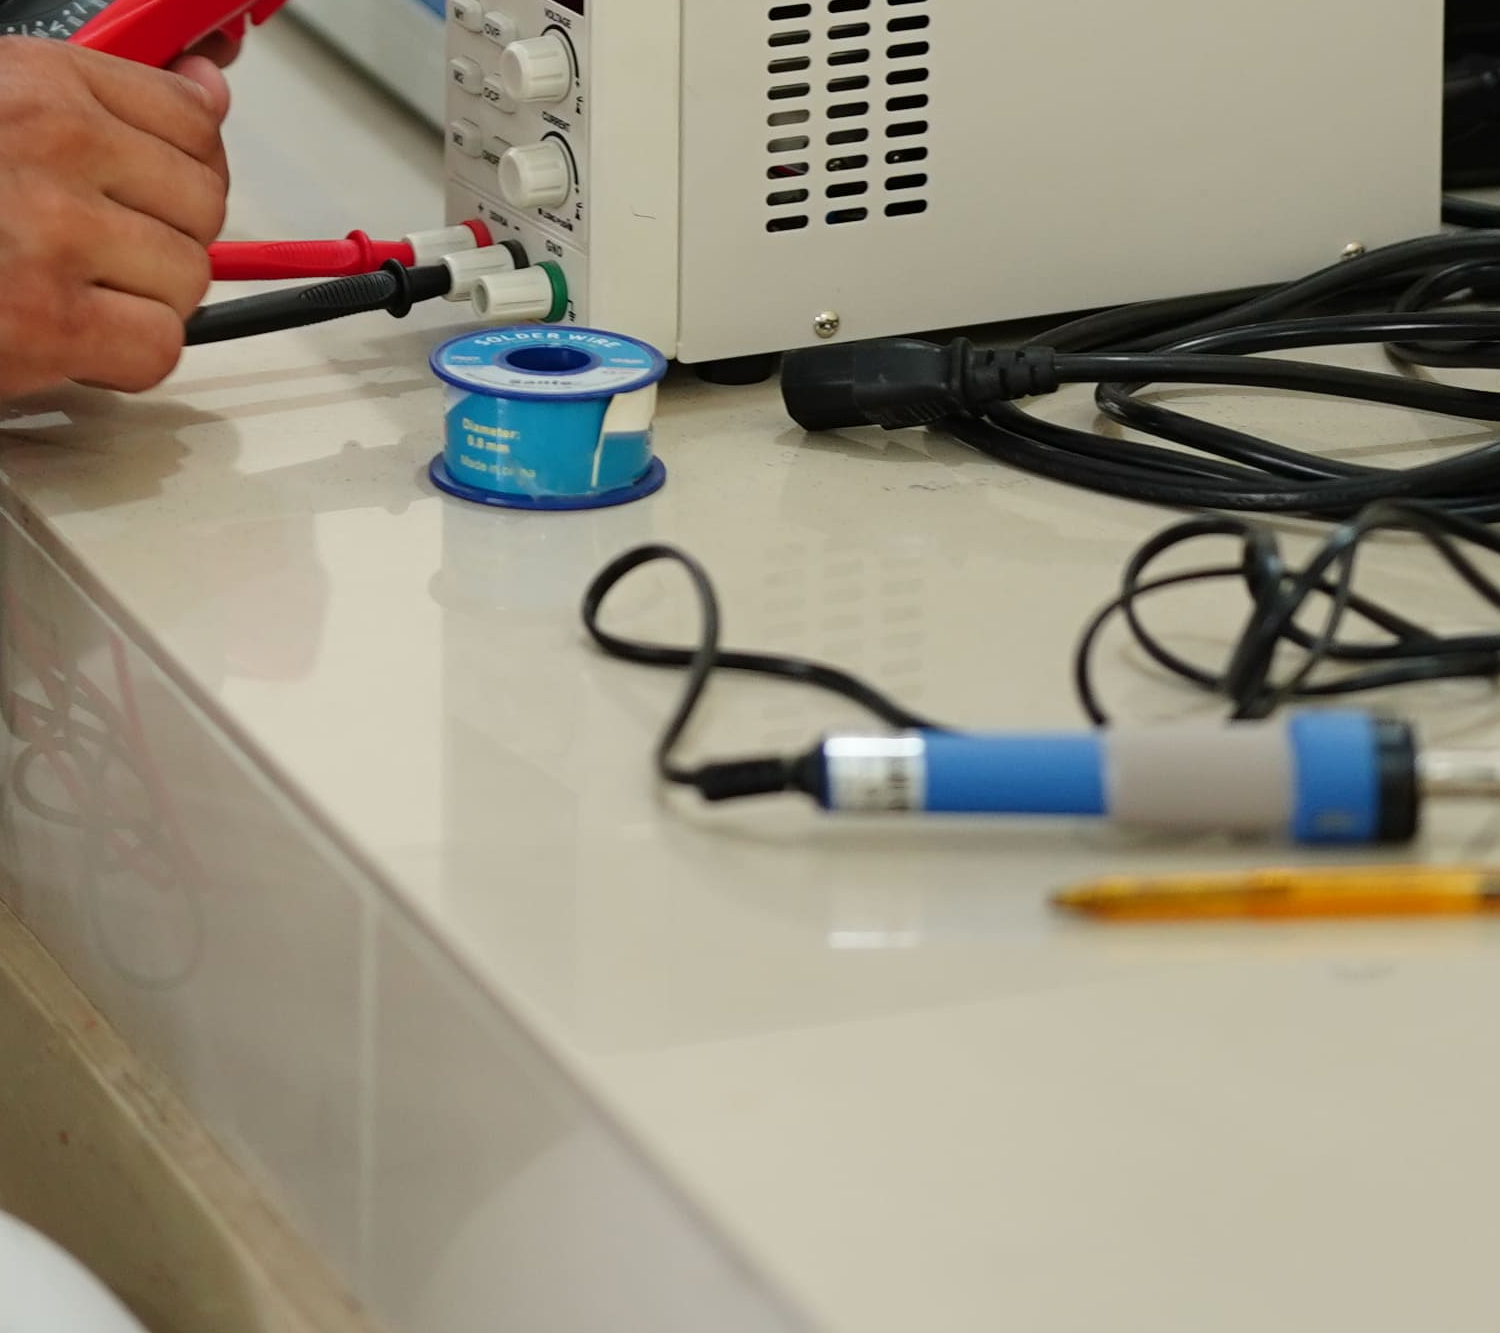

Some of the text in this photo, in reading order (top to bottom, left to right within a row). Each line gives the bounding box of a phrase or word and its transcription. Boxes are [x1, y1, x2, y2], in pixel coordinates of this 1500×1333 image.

[544, 7, 572, 29] VOLTAGE
[483, 23, 501, 38] OVP
[545, 239, 563, 258] GND
[474, 332, 622, 348] SOLDER WIRE
[463, 418, 521, 439] Diameter:
[486, 441, 511, 454] mm
